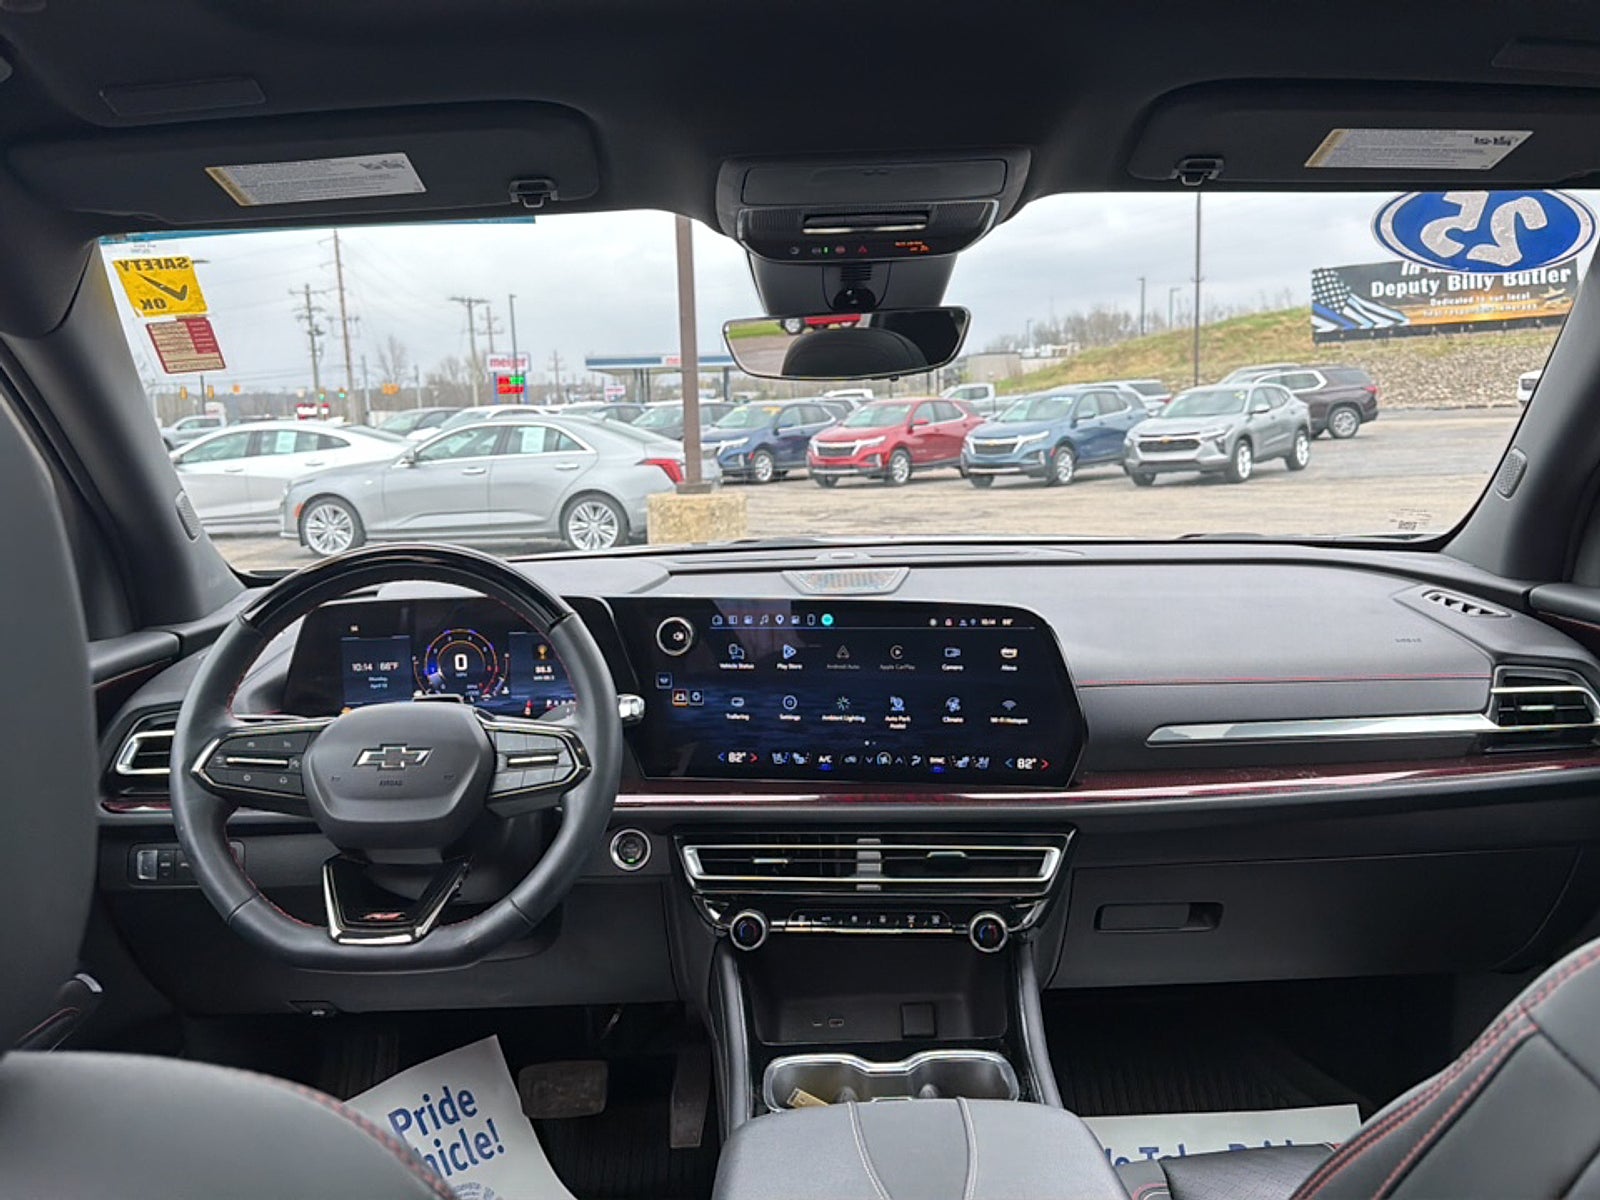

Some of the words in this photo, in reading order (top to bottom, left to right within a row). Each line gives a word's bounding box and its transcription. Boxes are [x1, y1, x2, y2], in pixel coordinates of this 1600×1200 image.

[1371, 278, 1441, 298] Deputy
[1447, 270, 1495, 292] Billy
[1503, 267, 1572, 287] Butler
[352, 663, 373, 671] 10:14
[454, 653, 468, 671] 0
[388, 1086, 478, 1138] Pride
